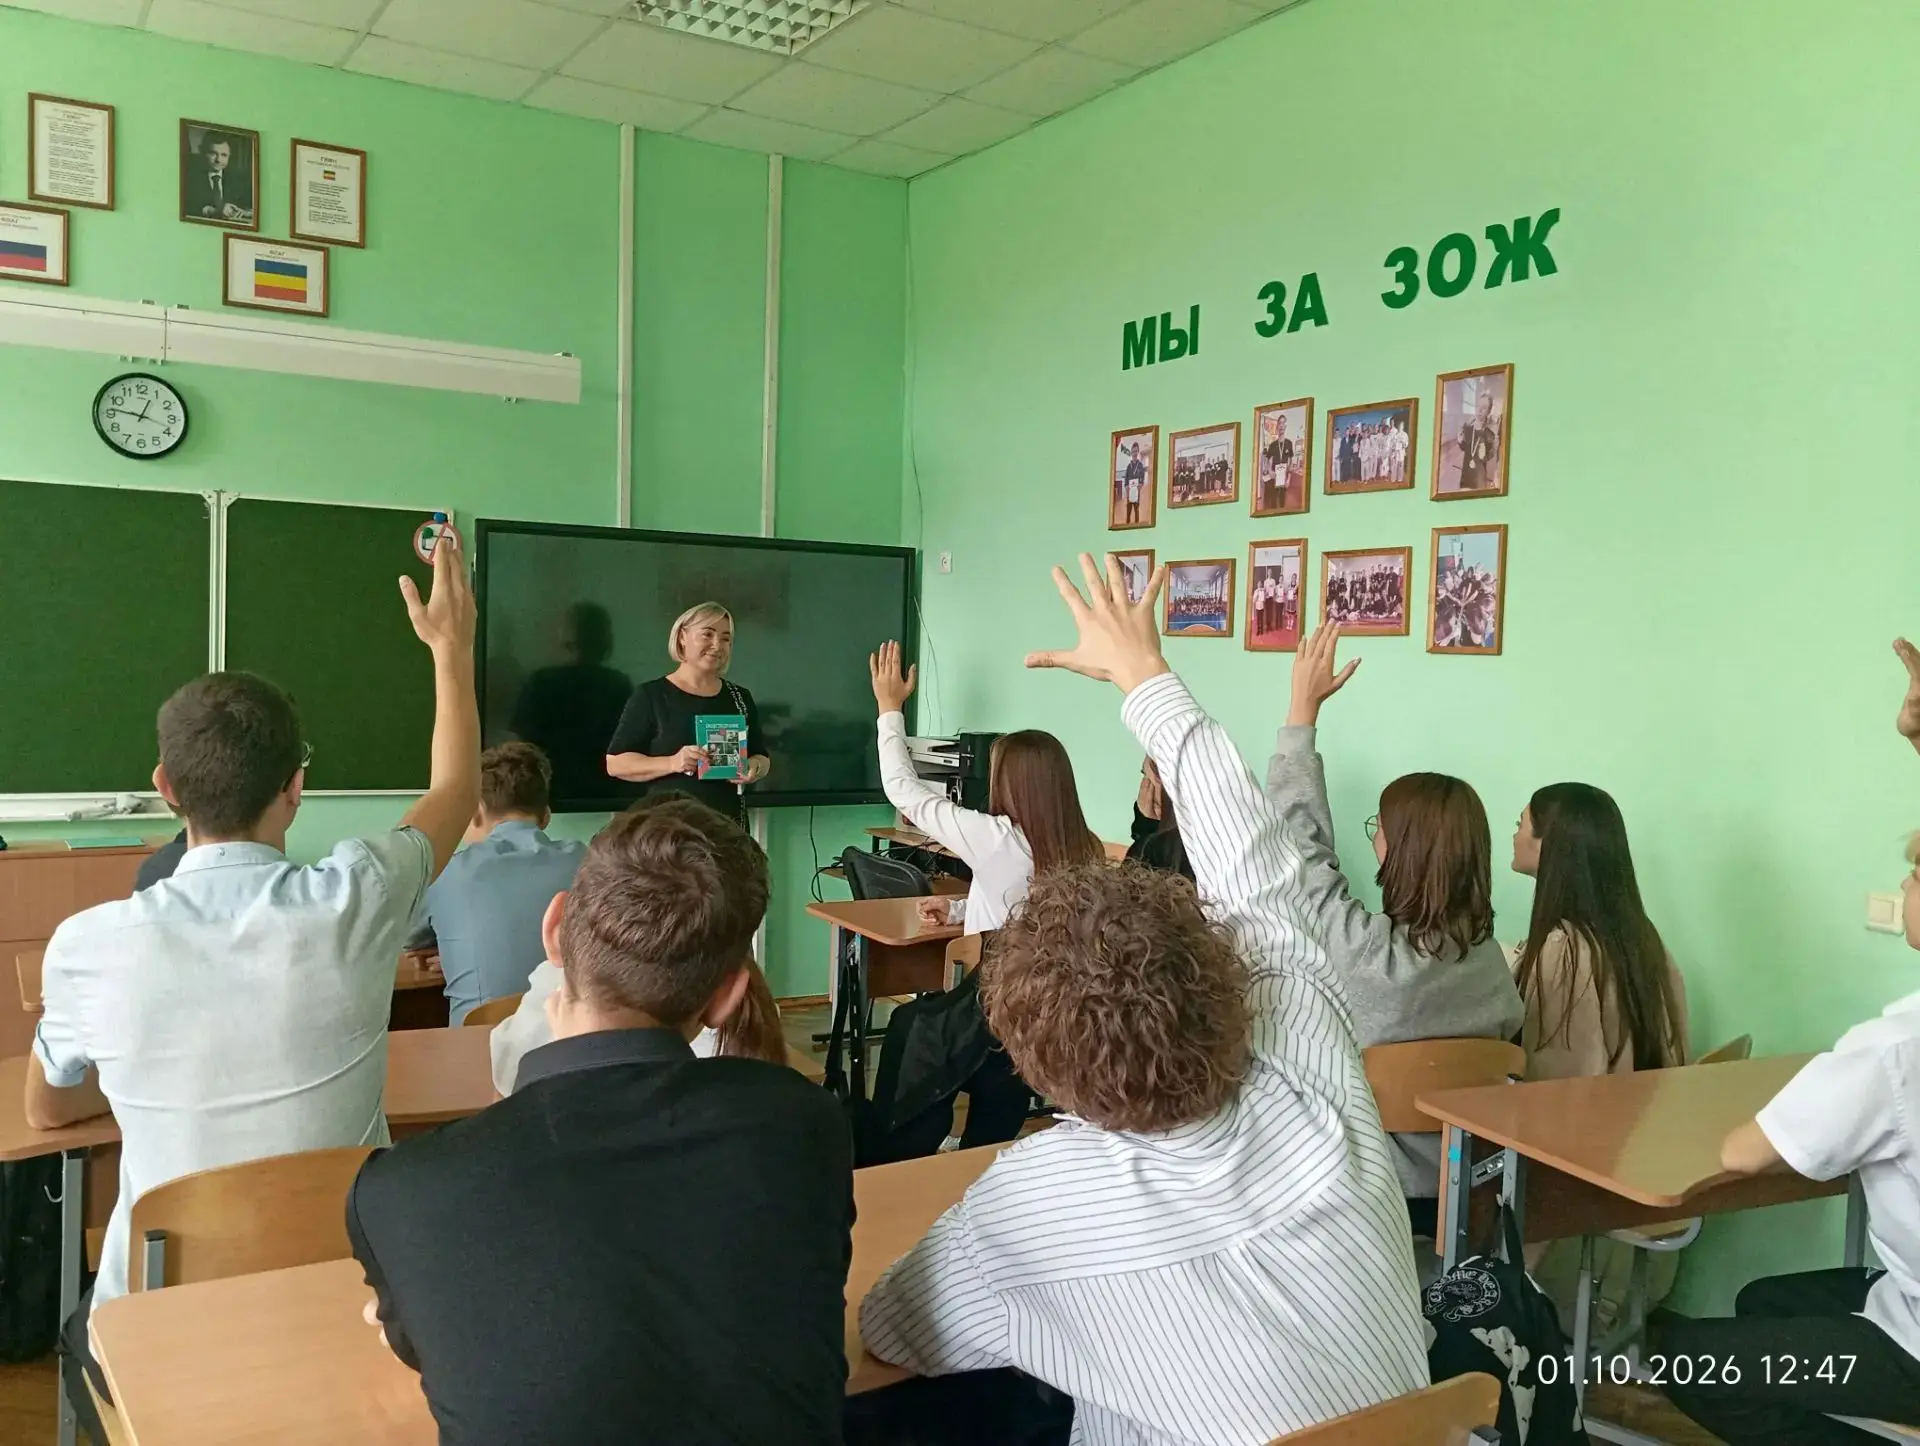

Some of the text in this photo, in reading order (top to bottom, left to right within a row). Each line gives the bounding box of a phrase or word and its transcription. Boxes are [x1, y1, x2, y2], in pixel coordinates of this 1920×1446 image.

[1122, 207, 1560, 371] МЫ ЗА ЗОЖ
[122, 386, 132, 397] 11
[136, 383, 148, 395] 12
[111, 394, 124, 406] 10
[163, 400, 172, 411] 2
[106, 408, 116, 419] 9
[168, 415, 176, 425] 3
[111, 422, 120, 433] 8
[162, 427, 172, 437] 4
[122, 433, 132, 444] 7
[137, 438, 146, 449] 6
[152, 435, 160, 446] 5
